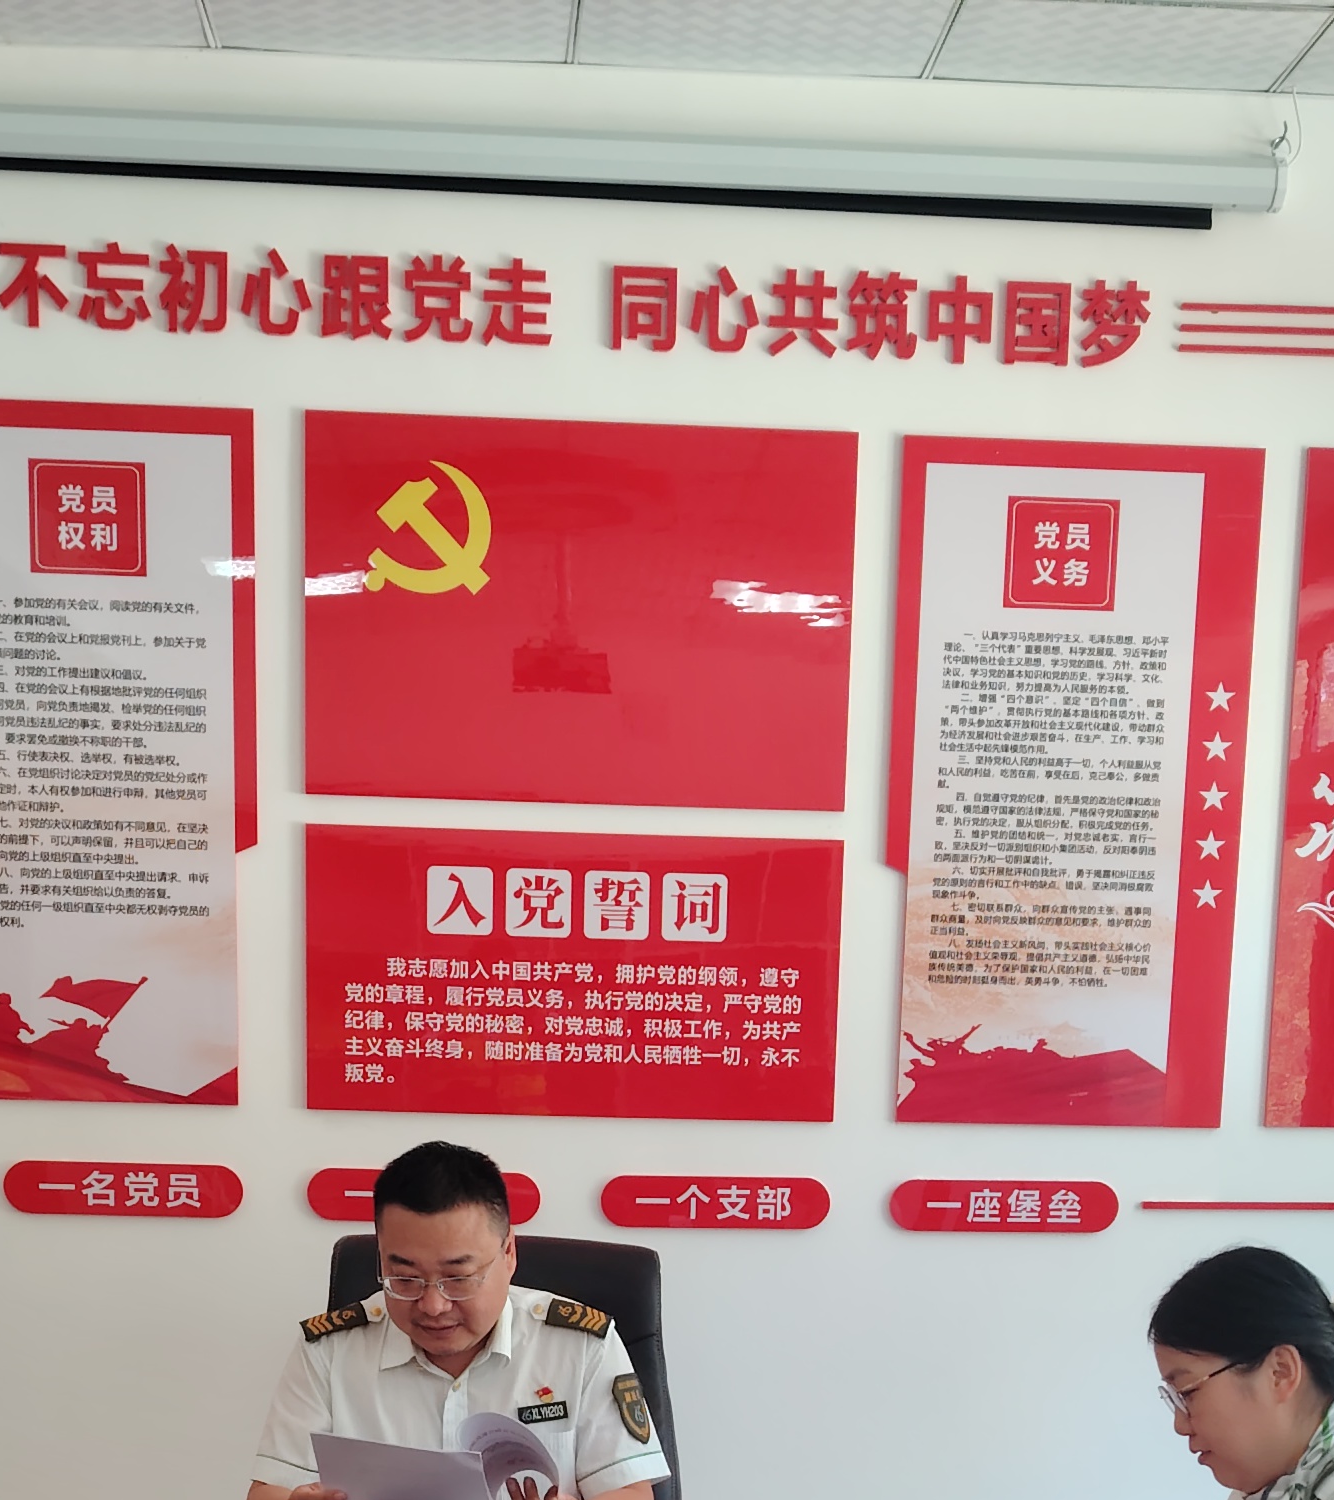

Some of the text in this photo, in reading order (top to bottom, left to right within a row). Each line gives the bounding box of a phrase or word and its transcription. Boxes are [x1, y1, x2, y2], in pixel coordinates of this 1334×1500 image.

[608, 264, 1151, 369] 同心共筑中国梦
[58, 484, 117, 514] 党员
[58, 521, 117, 551] 权利
[1034, 522, 1090, 550] 党员
[1031, 558, 1089, 586] 义务
[433, 872, 722, 935] 入党誓词
[386, 957, 799, 989] 我志愿加入中国共产党，拥护党的纲领，遵守
[344, 983, 801, 1016] 党的章程，履行党员义务，执行党的决定，严守党的
[344, 1010, 801, 1042] 纪律，保守党的秘密，对党忠诚，积极工作，为共产
[344, 1037, 799, 1068] 主义奋斗终身，随时准备为党和人民牺牲一切，永不
[344, 1064, 396, 1085] 叛党。
[38, 1170, 201, 1209] 一名党员
[635, 1184, 792, 1222] 一个支部
[927, 1188, 1082, 1225] 一座堡垒
